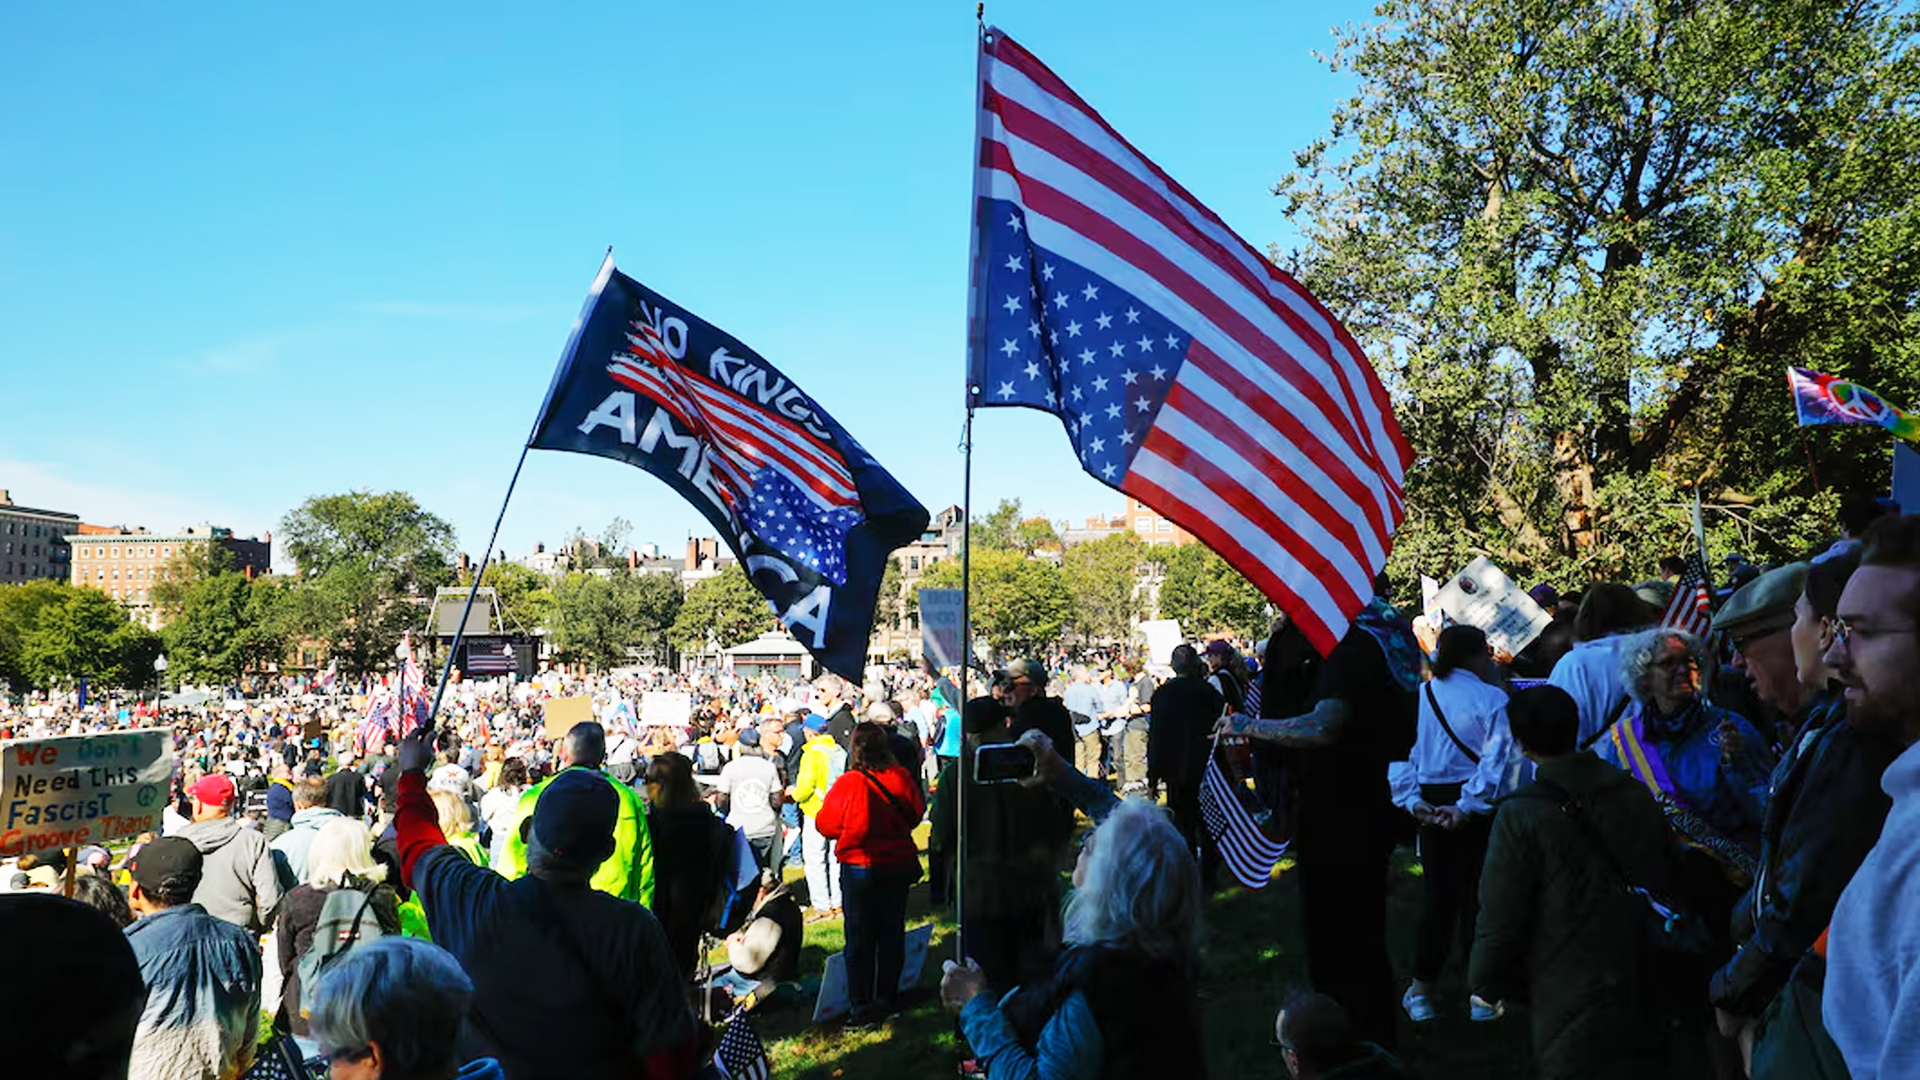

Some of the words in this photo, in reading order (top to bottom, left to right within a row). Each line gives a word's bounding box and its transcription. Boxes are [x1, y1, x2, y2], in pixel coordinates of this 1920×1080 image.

[640, 300, 689, 360] NO
[577, 390, 832, 649] AMECA
[16, 743, 58, 767] We
[14, 769, 80, 797] Need
[0, 826, 90, 854] Groove
[101, 815, 153, 838] Thang
